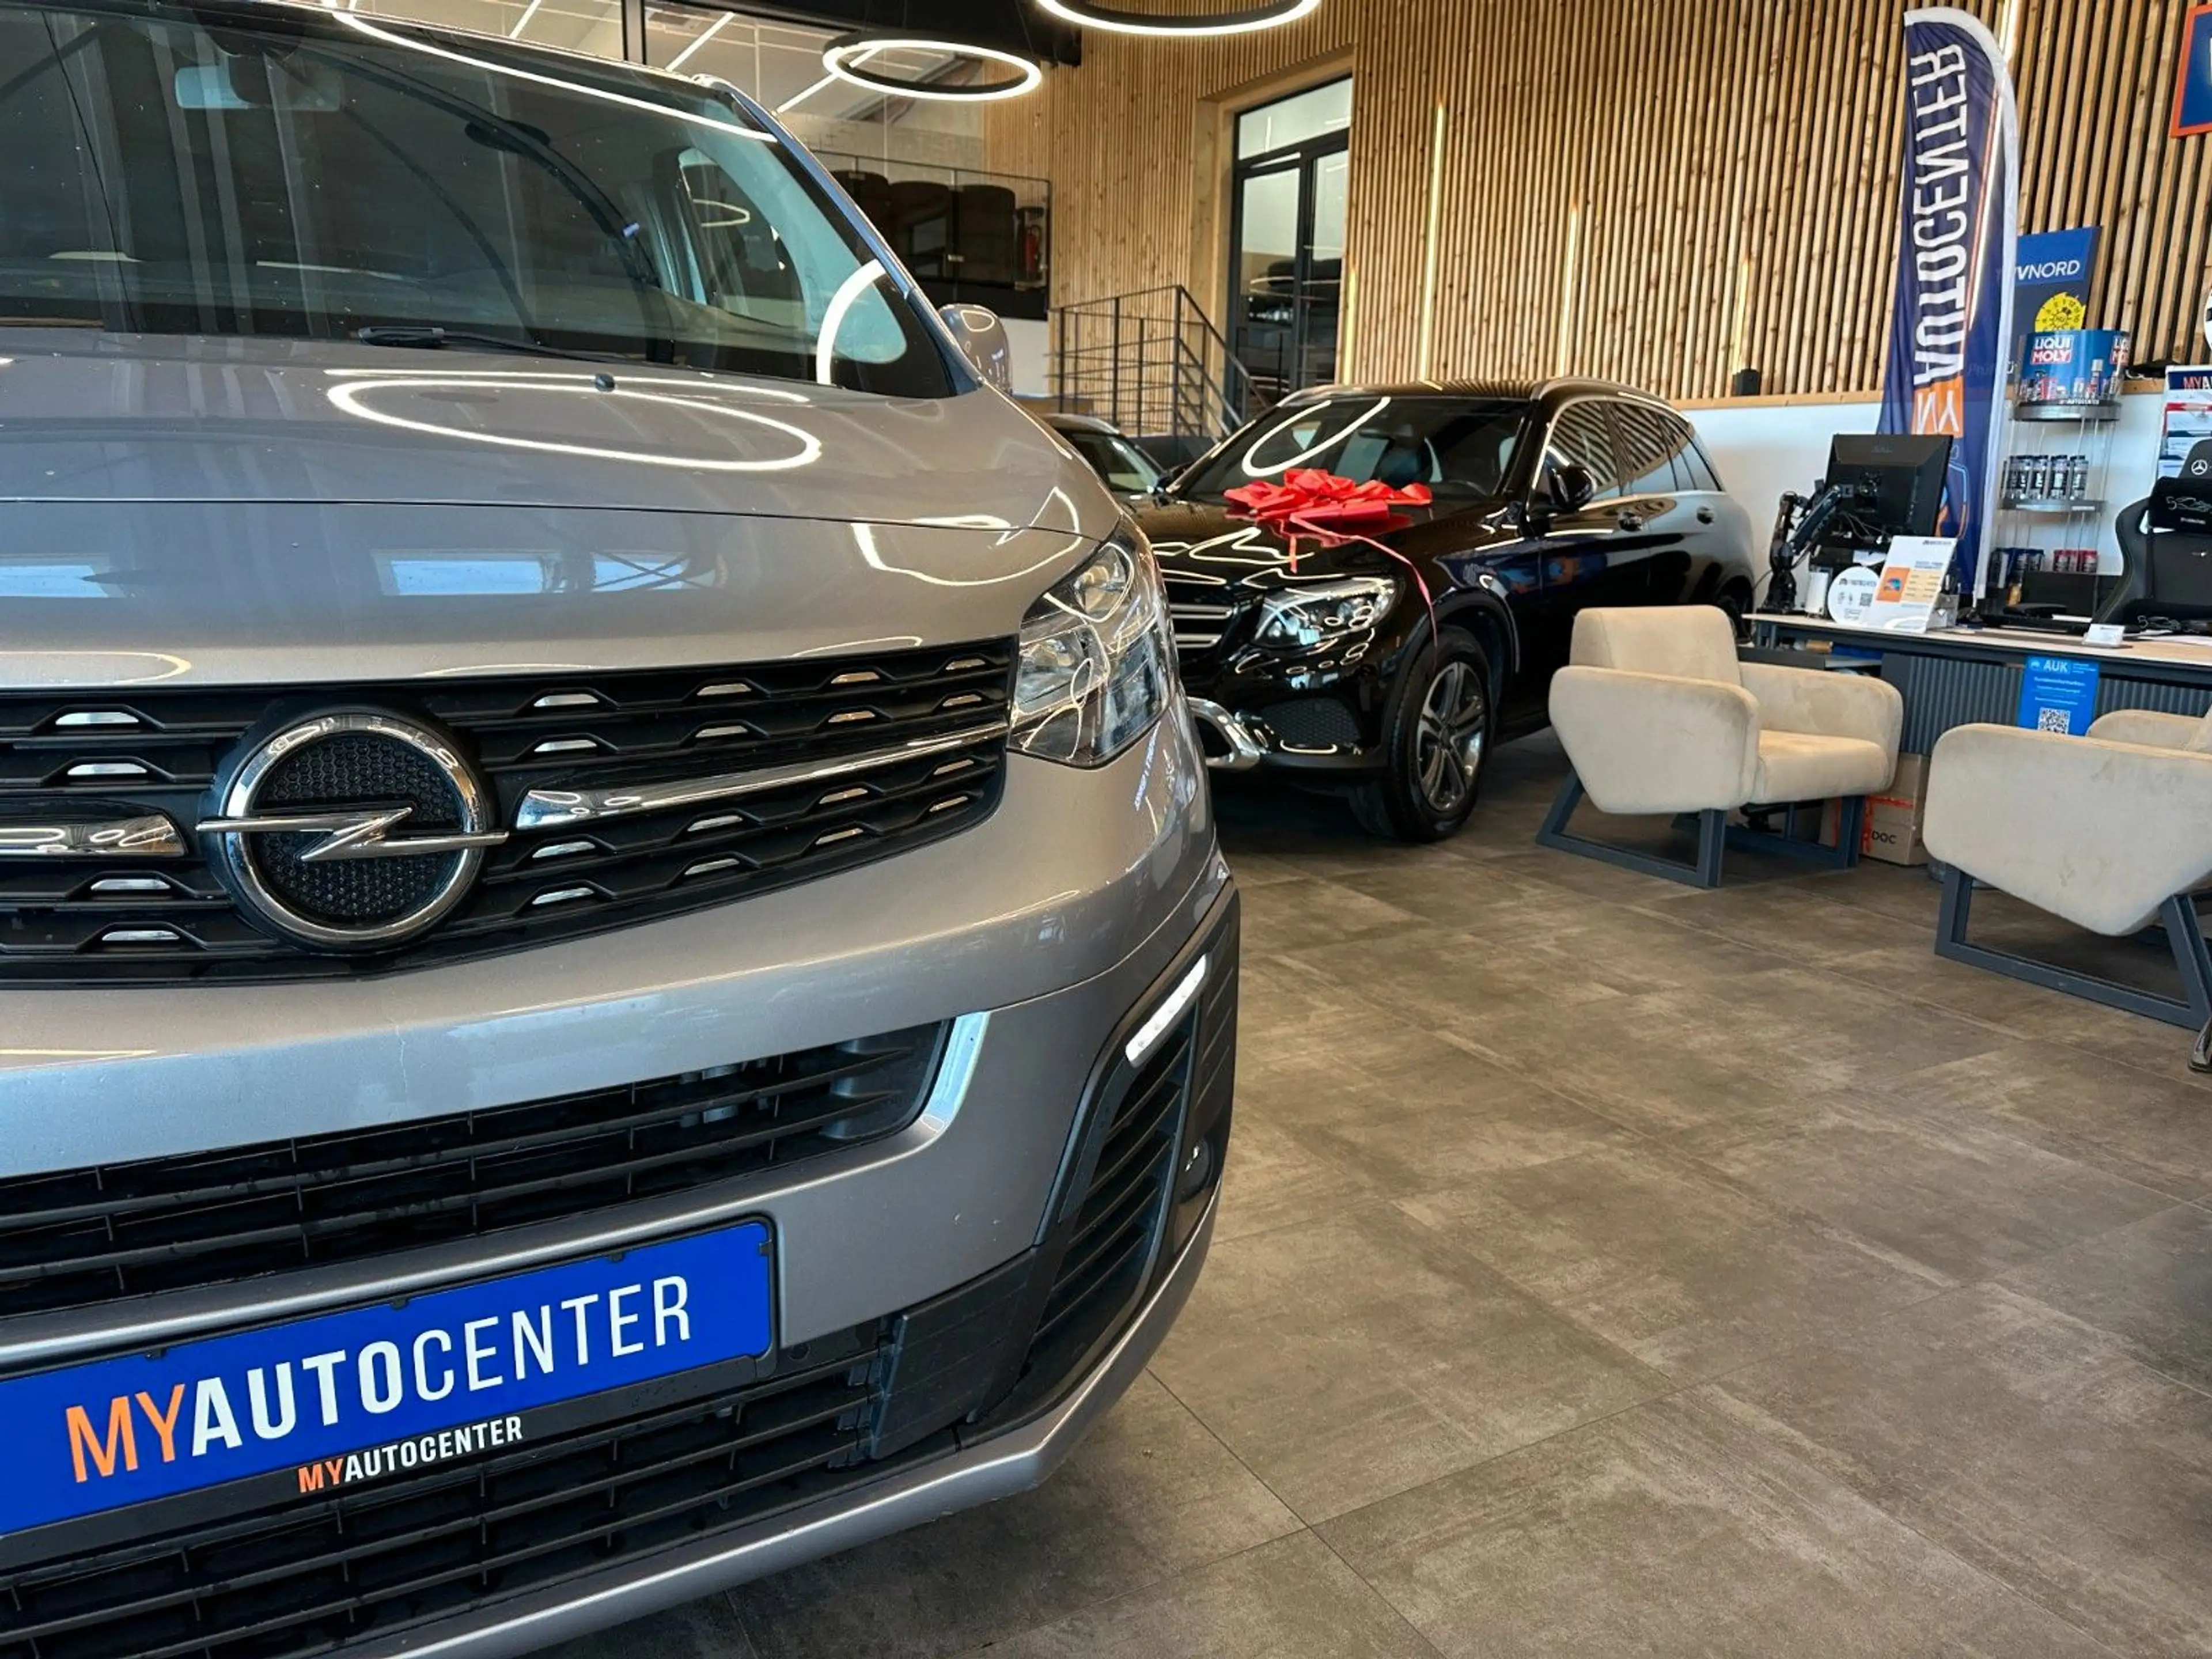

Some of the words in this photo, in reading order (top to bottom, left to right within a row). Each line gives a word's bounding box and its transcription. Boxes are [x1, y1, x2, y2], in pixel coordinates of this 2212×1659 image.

[2015, 259, 2081, 281] VNORD
[2033, 336, 2071, 349] LIQUI
[2031, 351, 2071, 363] MOLY
[2043, 659, 2069, 673] AUK
[65, 1275, 691, 1484] MYAUTOCENTER
[298, 1415, 523, 1493] MYAUTOCENTER
